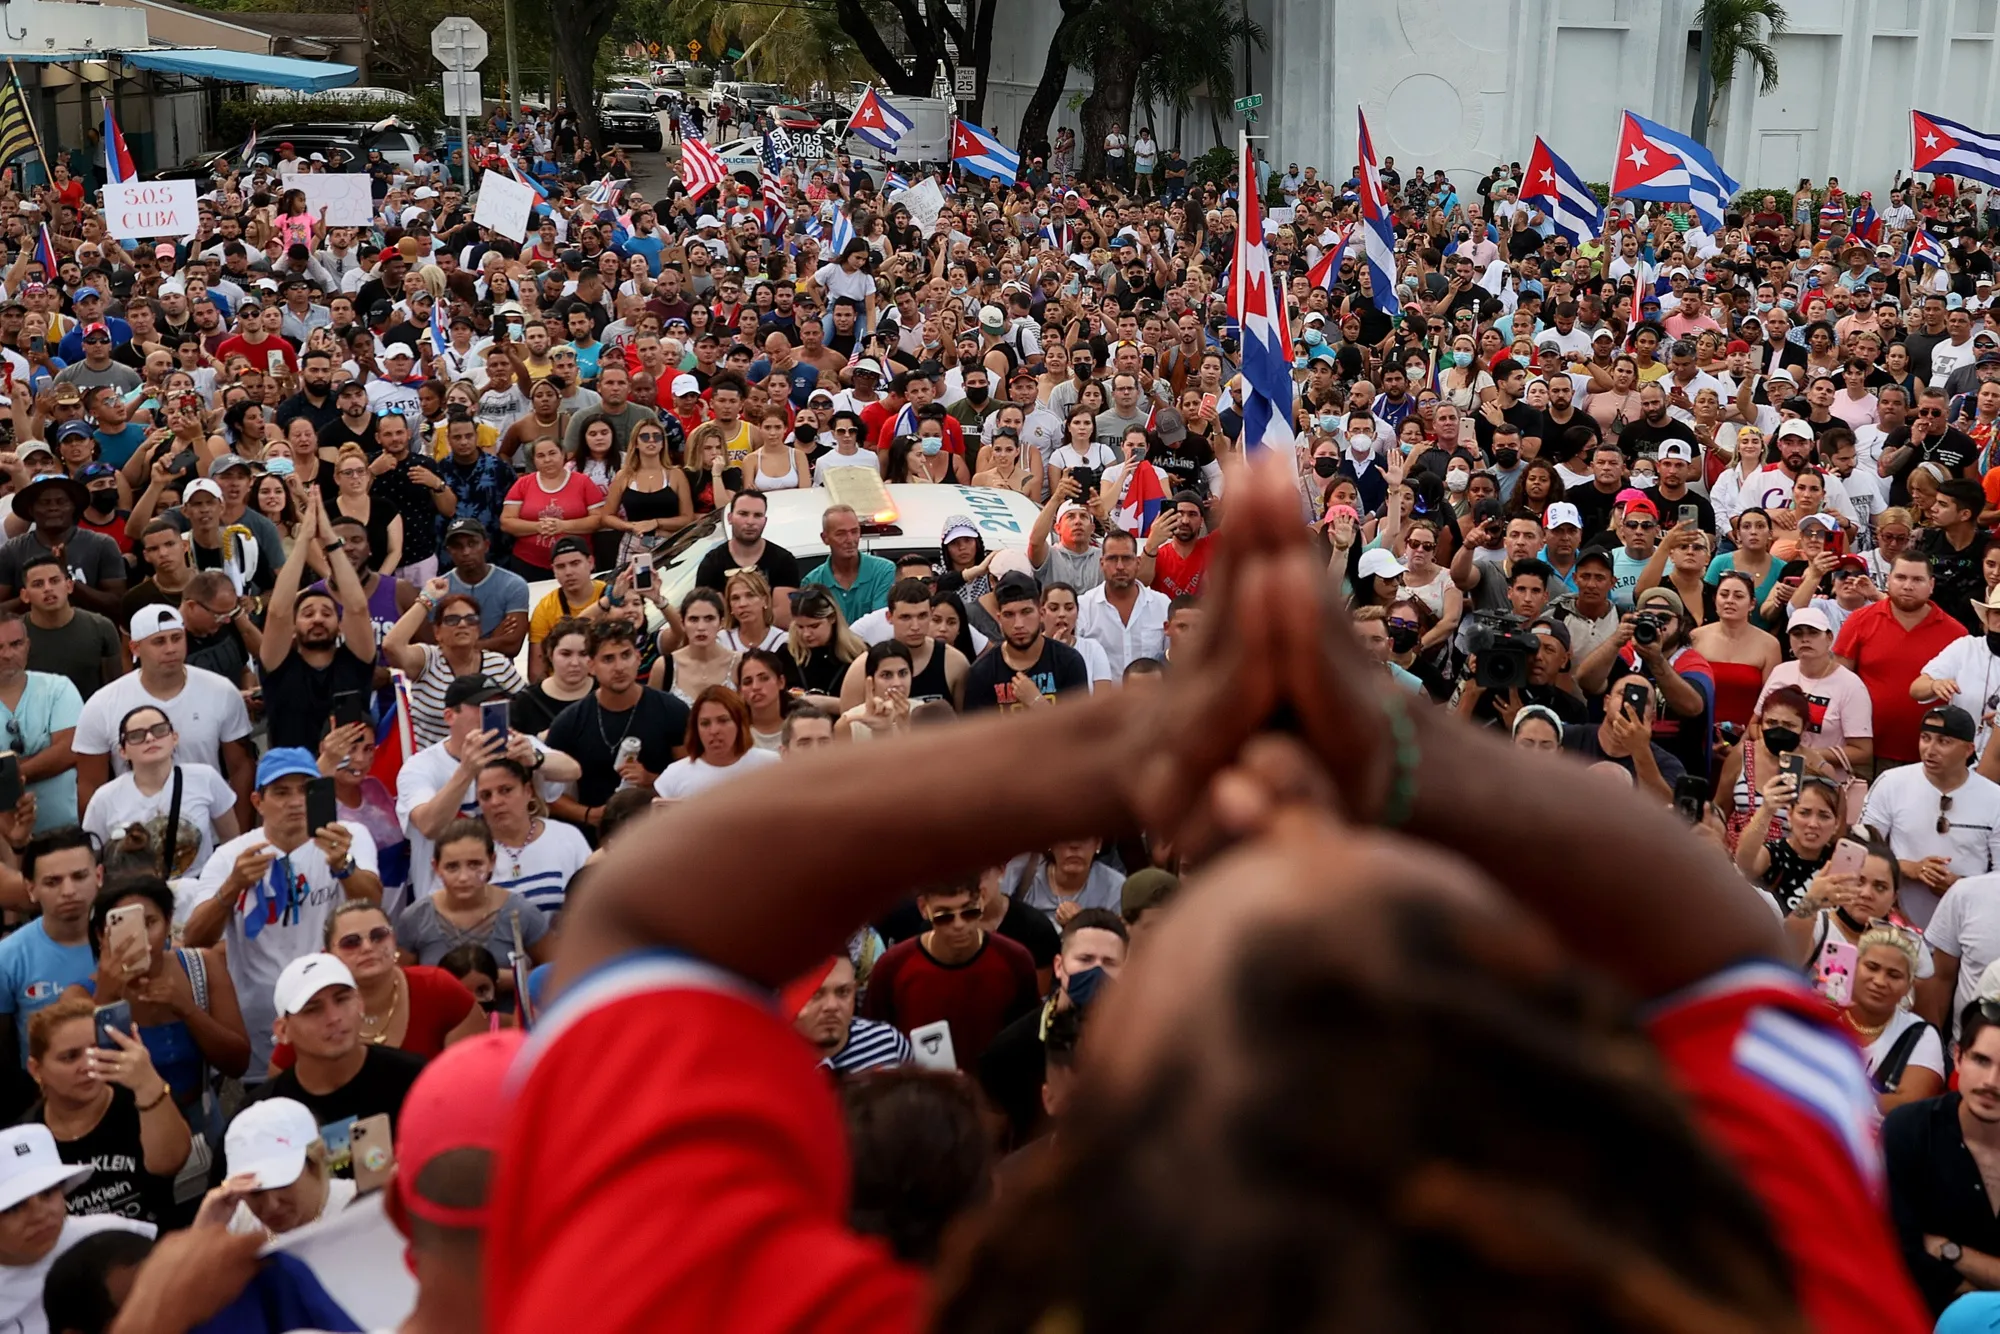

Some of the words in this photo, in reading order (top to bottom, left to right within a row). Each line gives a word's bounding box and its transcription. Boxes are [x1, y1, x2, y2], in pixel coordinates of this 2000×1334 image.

[957, 80, 974, 91] 25
[1247, 98, 1252, 107] 8
[792, 145, 824, 158] CUBA
[121, 211, 180, 229] CUBA
[91, 1155, 135, 1173] KLEIN
